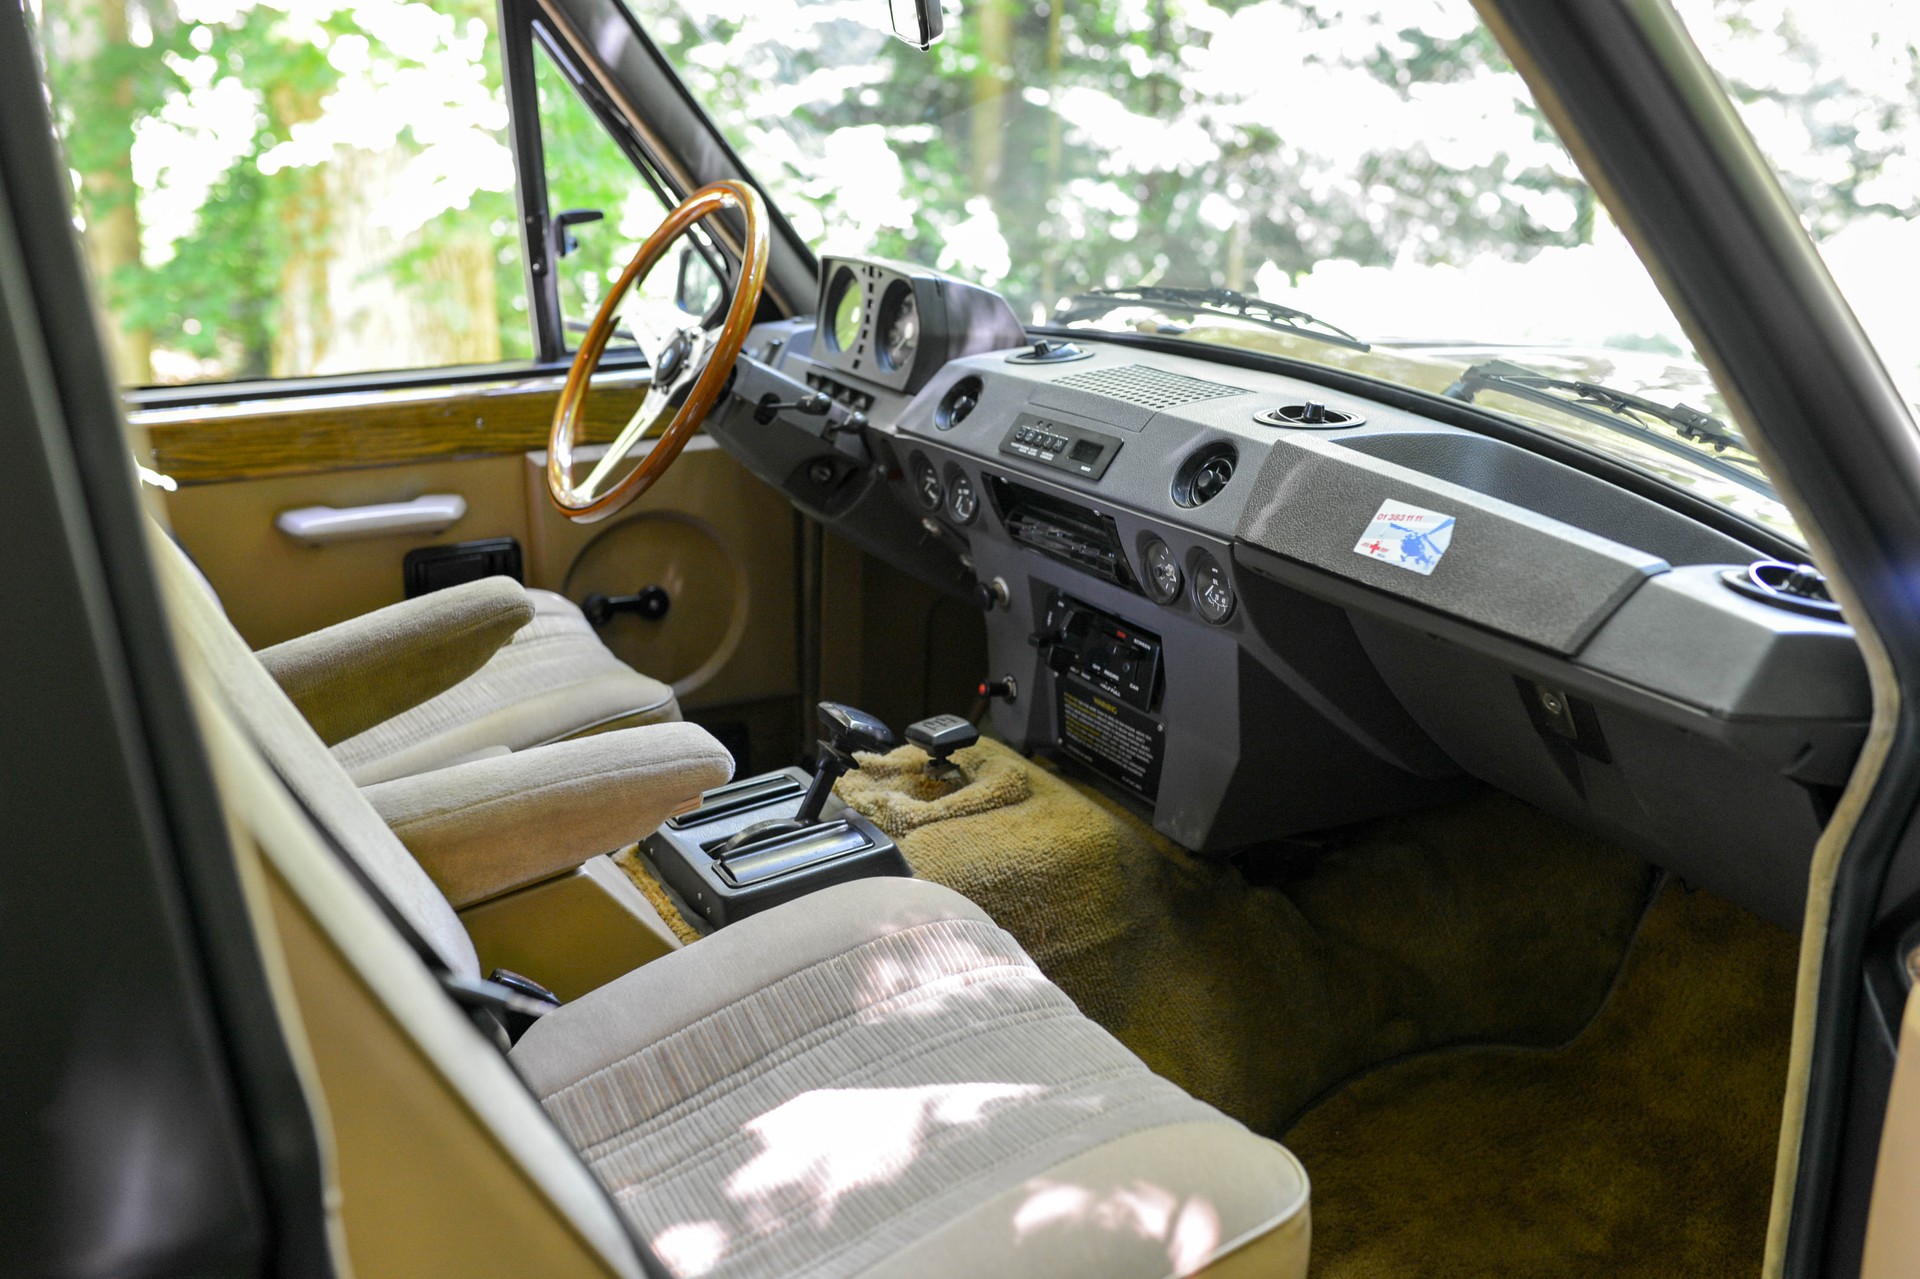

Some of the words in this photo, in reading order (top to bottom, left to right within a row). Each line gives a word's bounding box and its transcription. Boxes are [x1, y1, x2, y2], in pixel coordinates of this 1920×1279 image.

[1377, 513, 1387, 521] 01
[1388, 513, 1406, 521] 383
[1407, 514, 1415, 522] 11
[1415, 514, 1424, 522] 11
